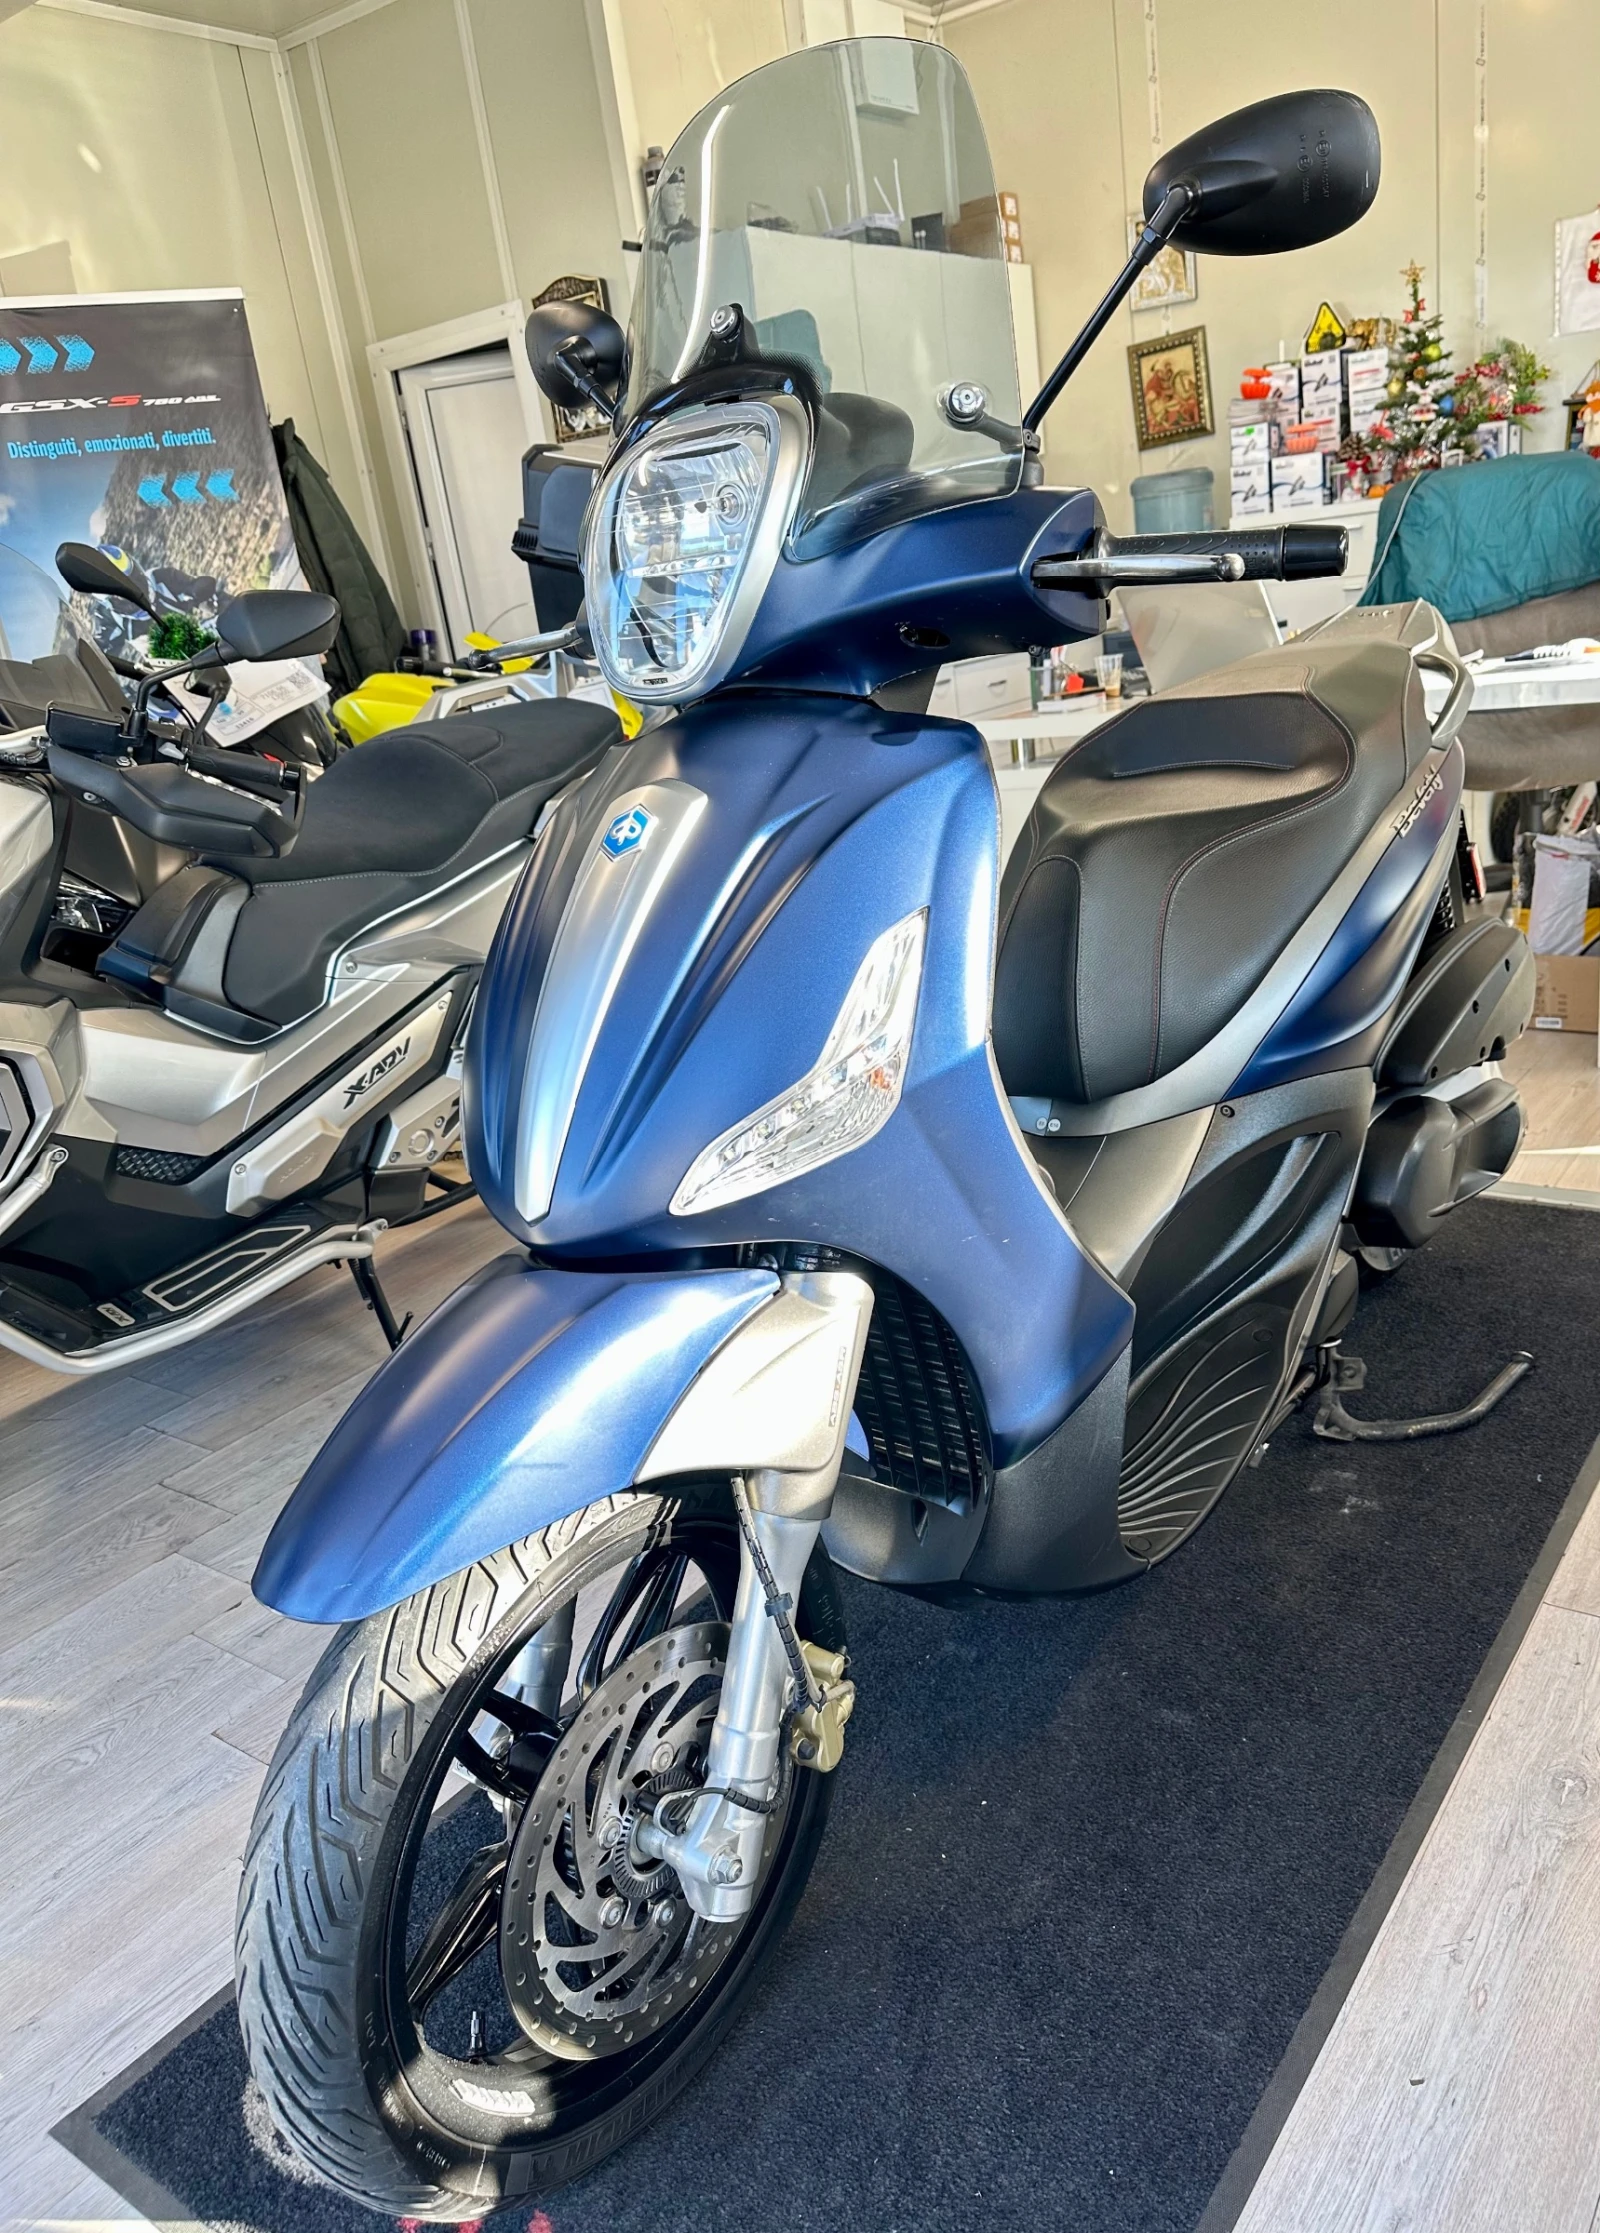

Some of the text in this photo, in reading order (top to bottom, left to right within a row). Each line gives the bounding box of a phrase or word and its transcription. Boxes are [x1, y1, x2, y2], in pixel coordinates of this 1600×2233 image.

[0, 394, 142, 414] GSX-S
[7, 426, 217, 460] Distinguiti, emozionati, divertiti.
